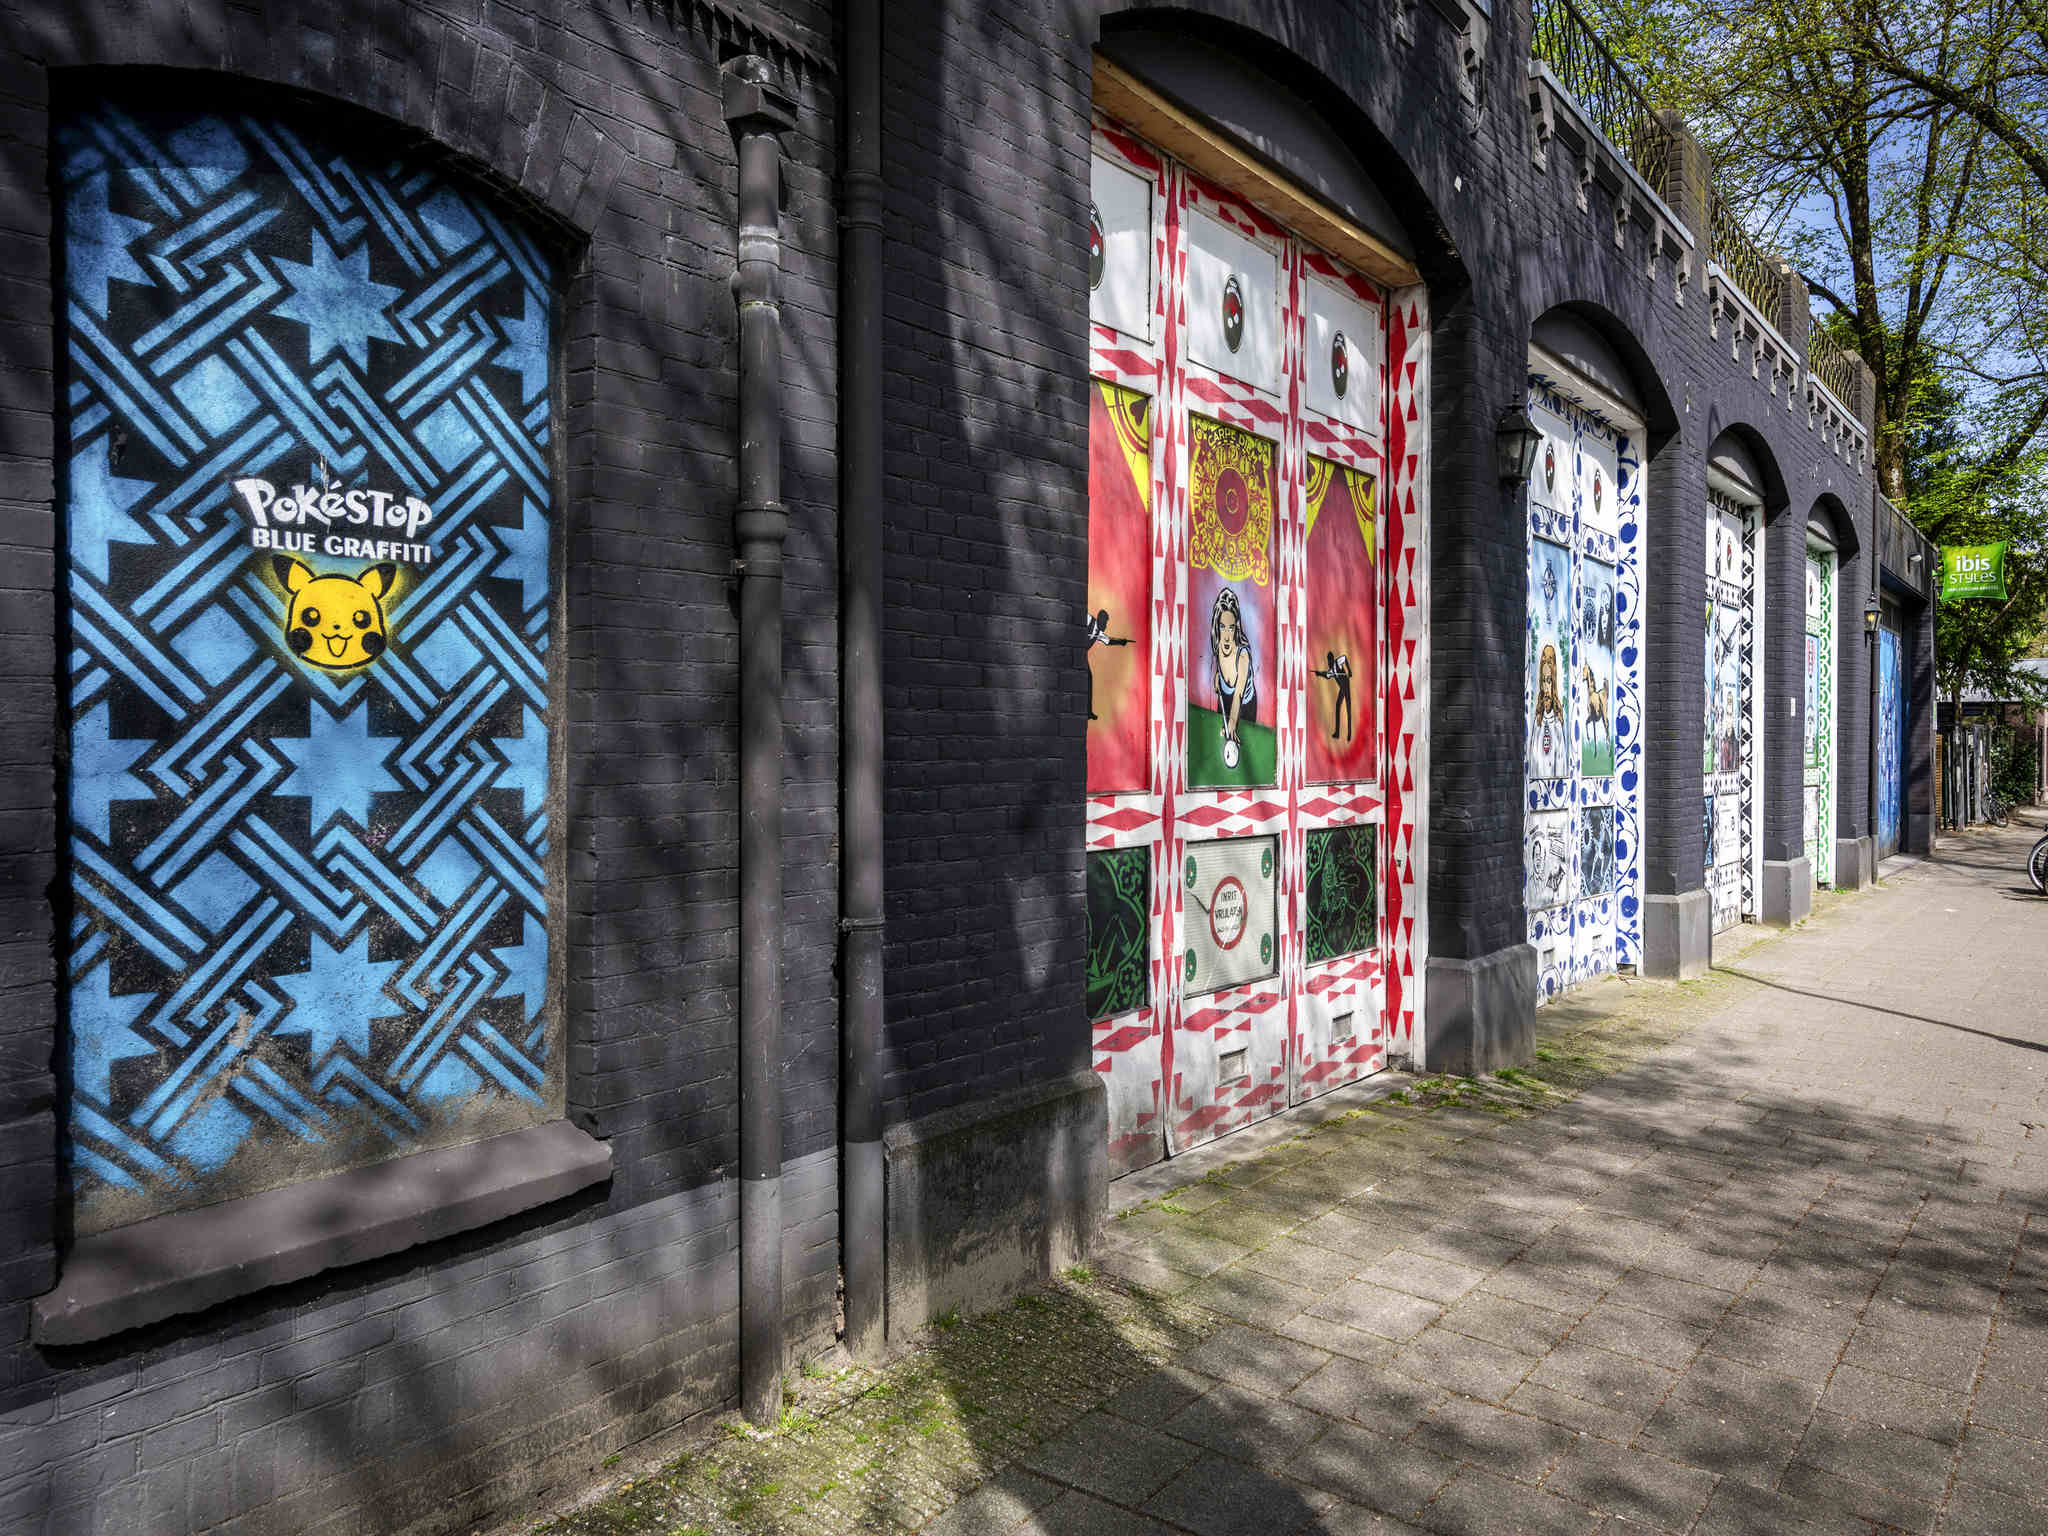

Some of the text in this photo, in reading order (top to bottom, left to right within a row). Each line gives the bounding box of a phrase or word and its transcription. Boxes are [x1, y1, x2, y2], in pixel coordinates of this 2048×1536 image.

[252, 527, 432, 564] BLUE GRAFFITI
[1956, 553, 1991, 572] ibis
